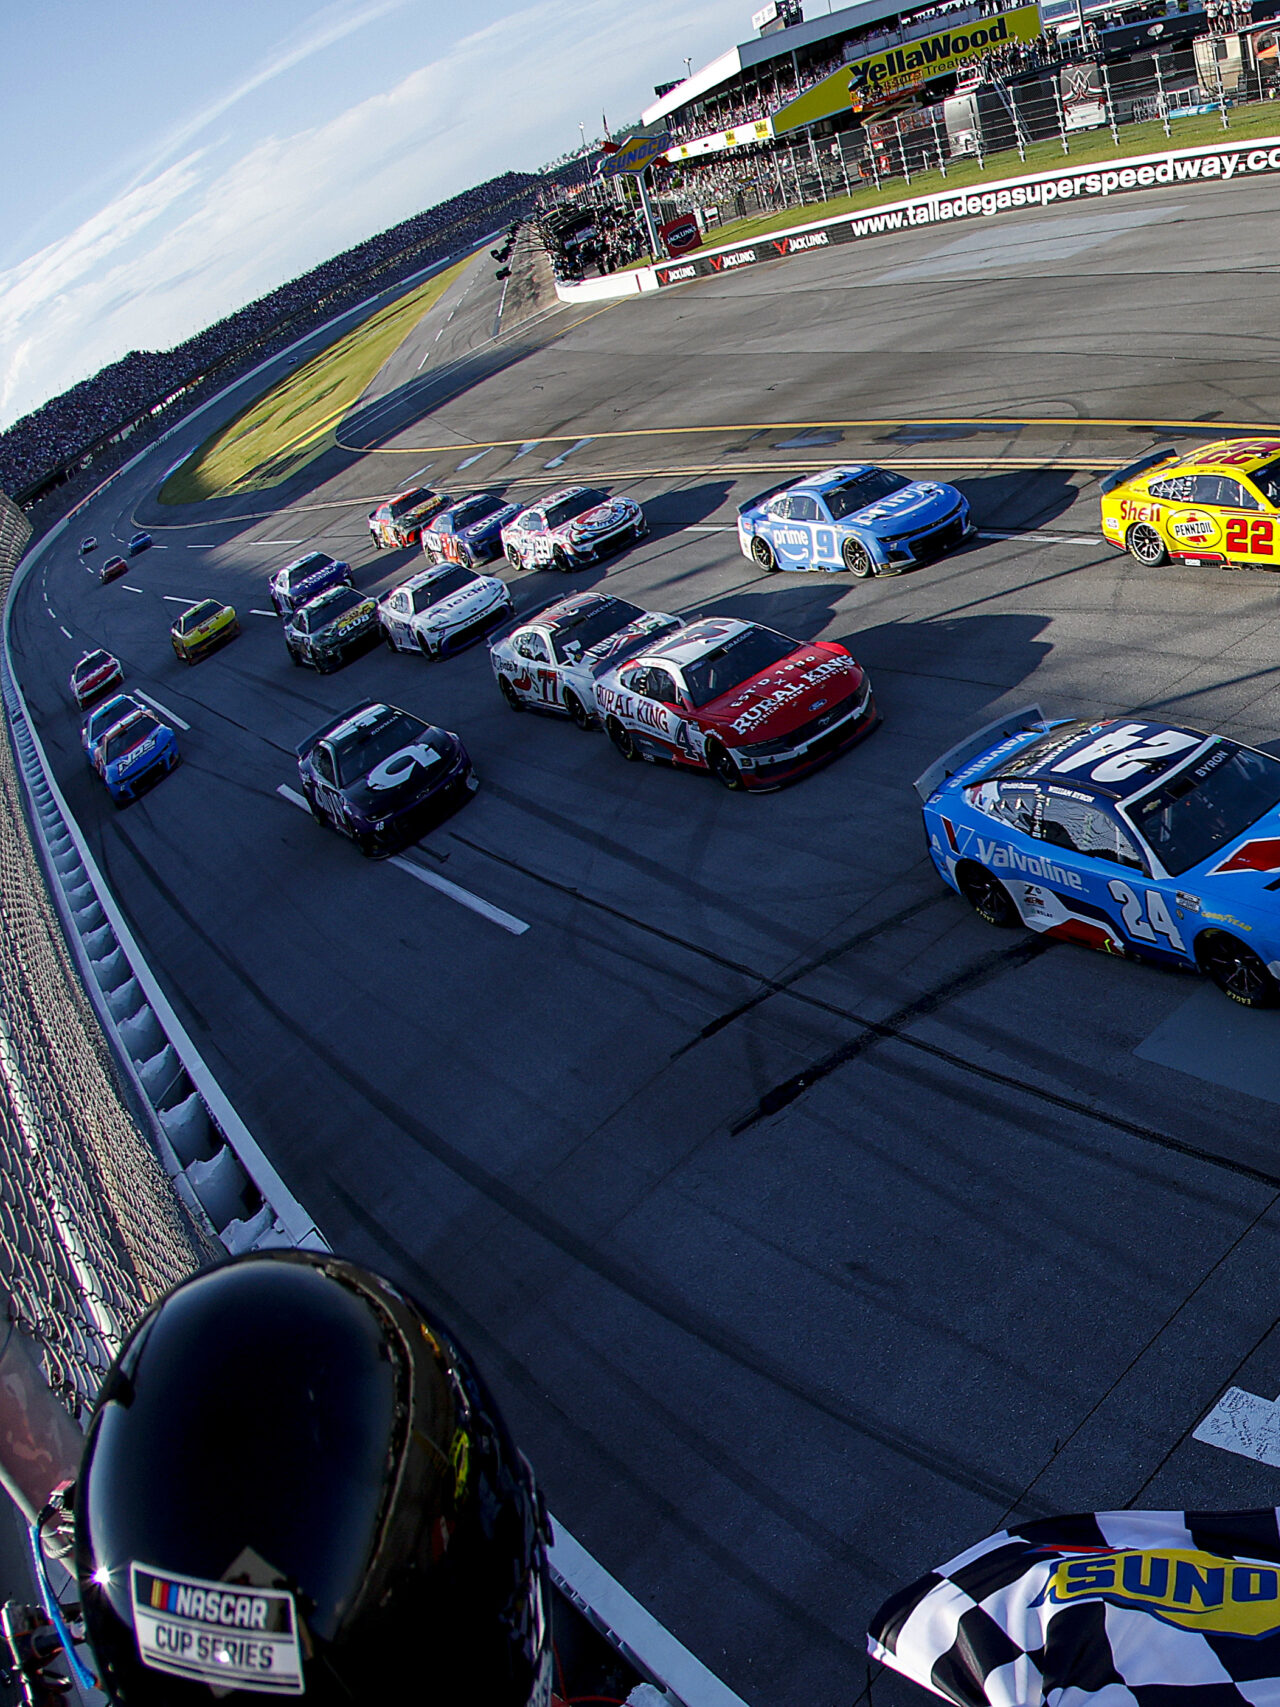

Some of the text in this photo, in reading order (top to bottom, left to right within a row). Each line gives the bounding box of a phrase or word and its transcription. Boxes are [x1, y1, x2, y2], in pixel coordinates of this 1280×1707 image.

[850, 18, 1008, 87] YellaWood
[605, 136, 670, 174] SUNOCO
[853, 481, 945, 527] prime
[1120, 500, 1161, 522] Shell
[773, 526, 808, 548] prime
[816, 530, 834, 560] 9
[1174, 521, 1214, 536] PENNZOIL
[1226, 518, 1273, 556] 22
[447, 581, 496, 609] leidos
[338, 614, 370, 637] CLUB
[538, 669, 558, 704] 77
[729, 677, 771, 708] EST'D
[730, 654, 856, 735] RURAL KING
[597, 685, 669, 735] RURAL KING
[675, 719, 701, 761] 4
[1195, 750, 1228, 778] BYRON
[975, 838, 1084, 892] Valvoline
[1107, 879, 1187, 952] 24
[174, 1579, 268, 1629] NASCAR
[154, 1621, 274, 1670] CUP SERIES
